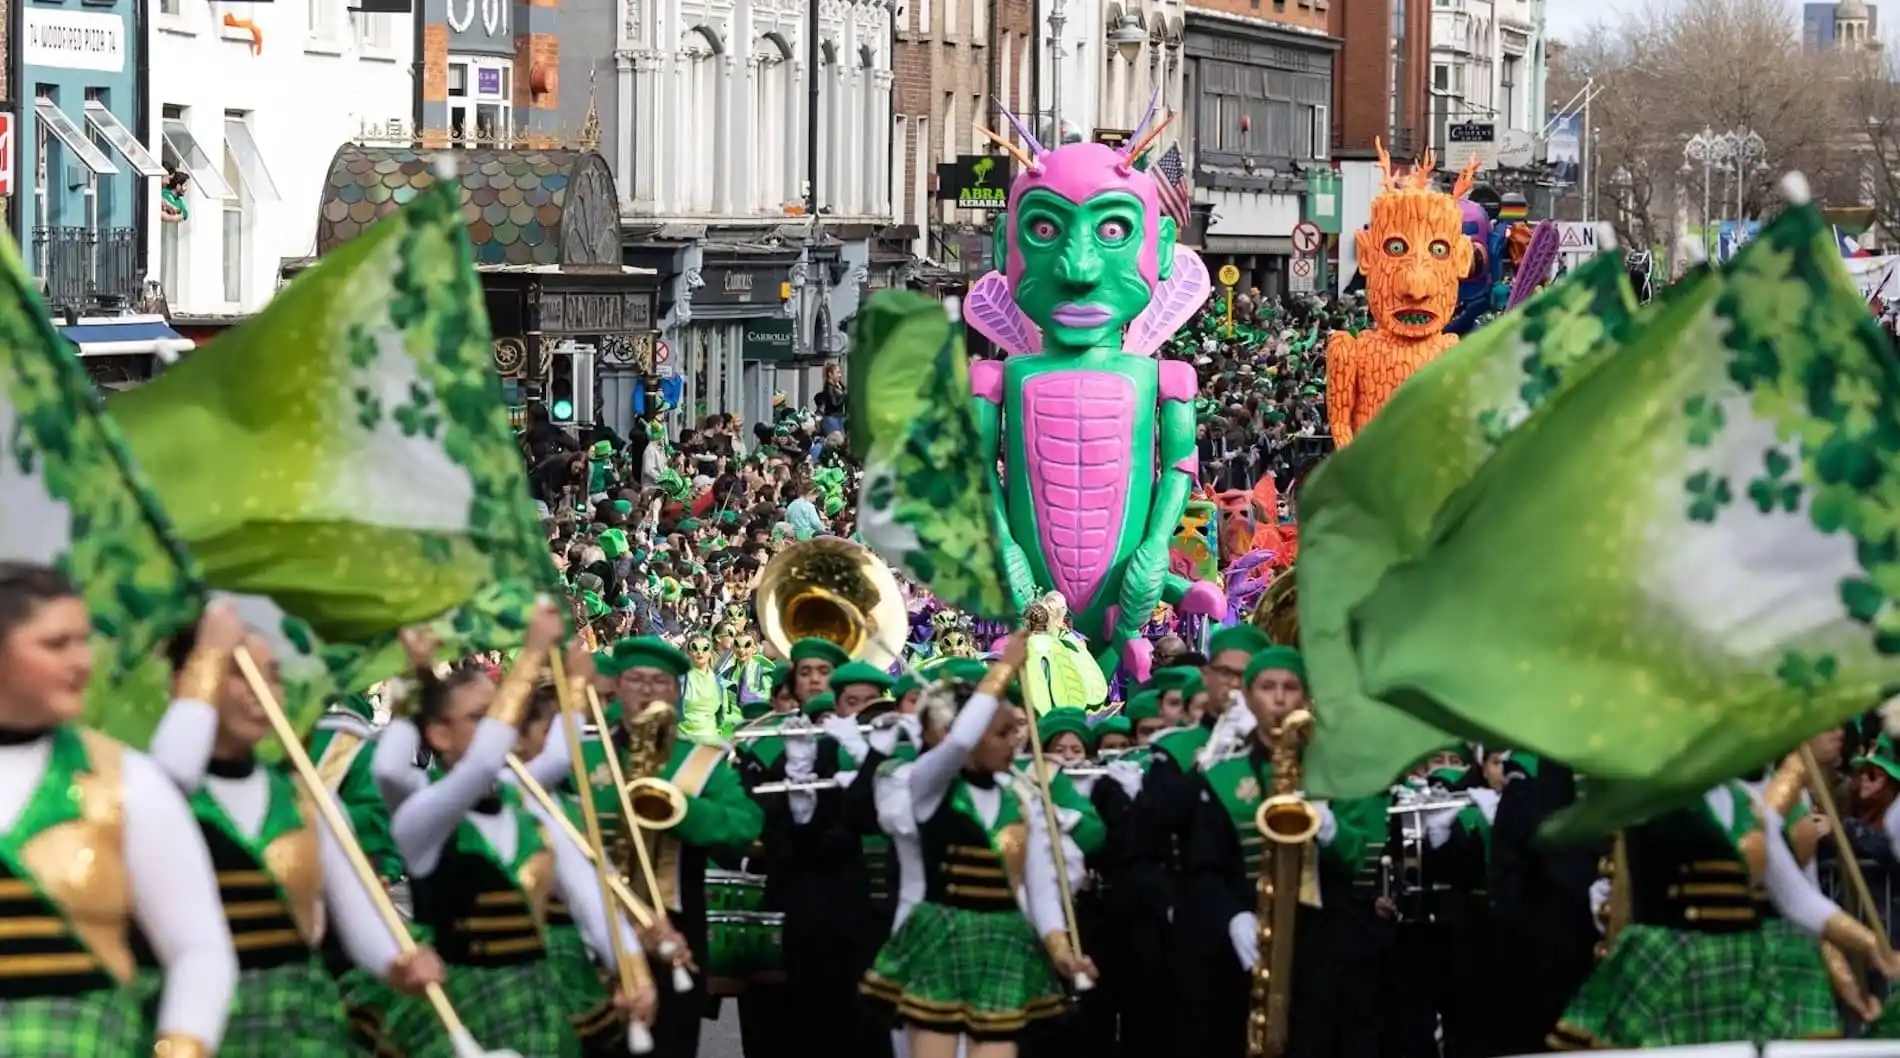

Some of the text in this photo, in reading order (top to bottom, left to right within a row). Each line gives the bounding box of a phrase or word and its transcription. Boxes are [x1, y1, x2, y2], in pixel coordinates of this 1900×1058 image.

[29, 23, 116, 53] 74 WOODFIRED PIZZA 74
[960, 188, 1005, 200] ABRA
[1583, 227, 1593, 246] N
[565, 294, 622, 329] OLYMPIA
[747, 331, 791, 341] CARROLLS
